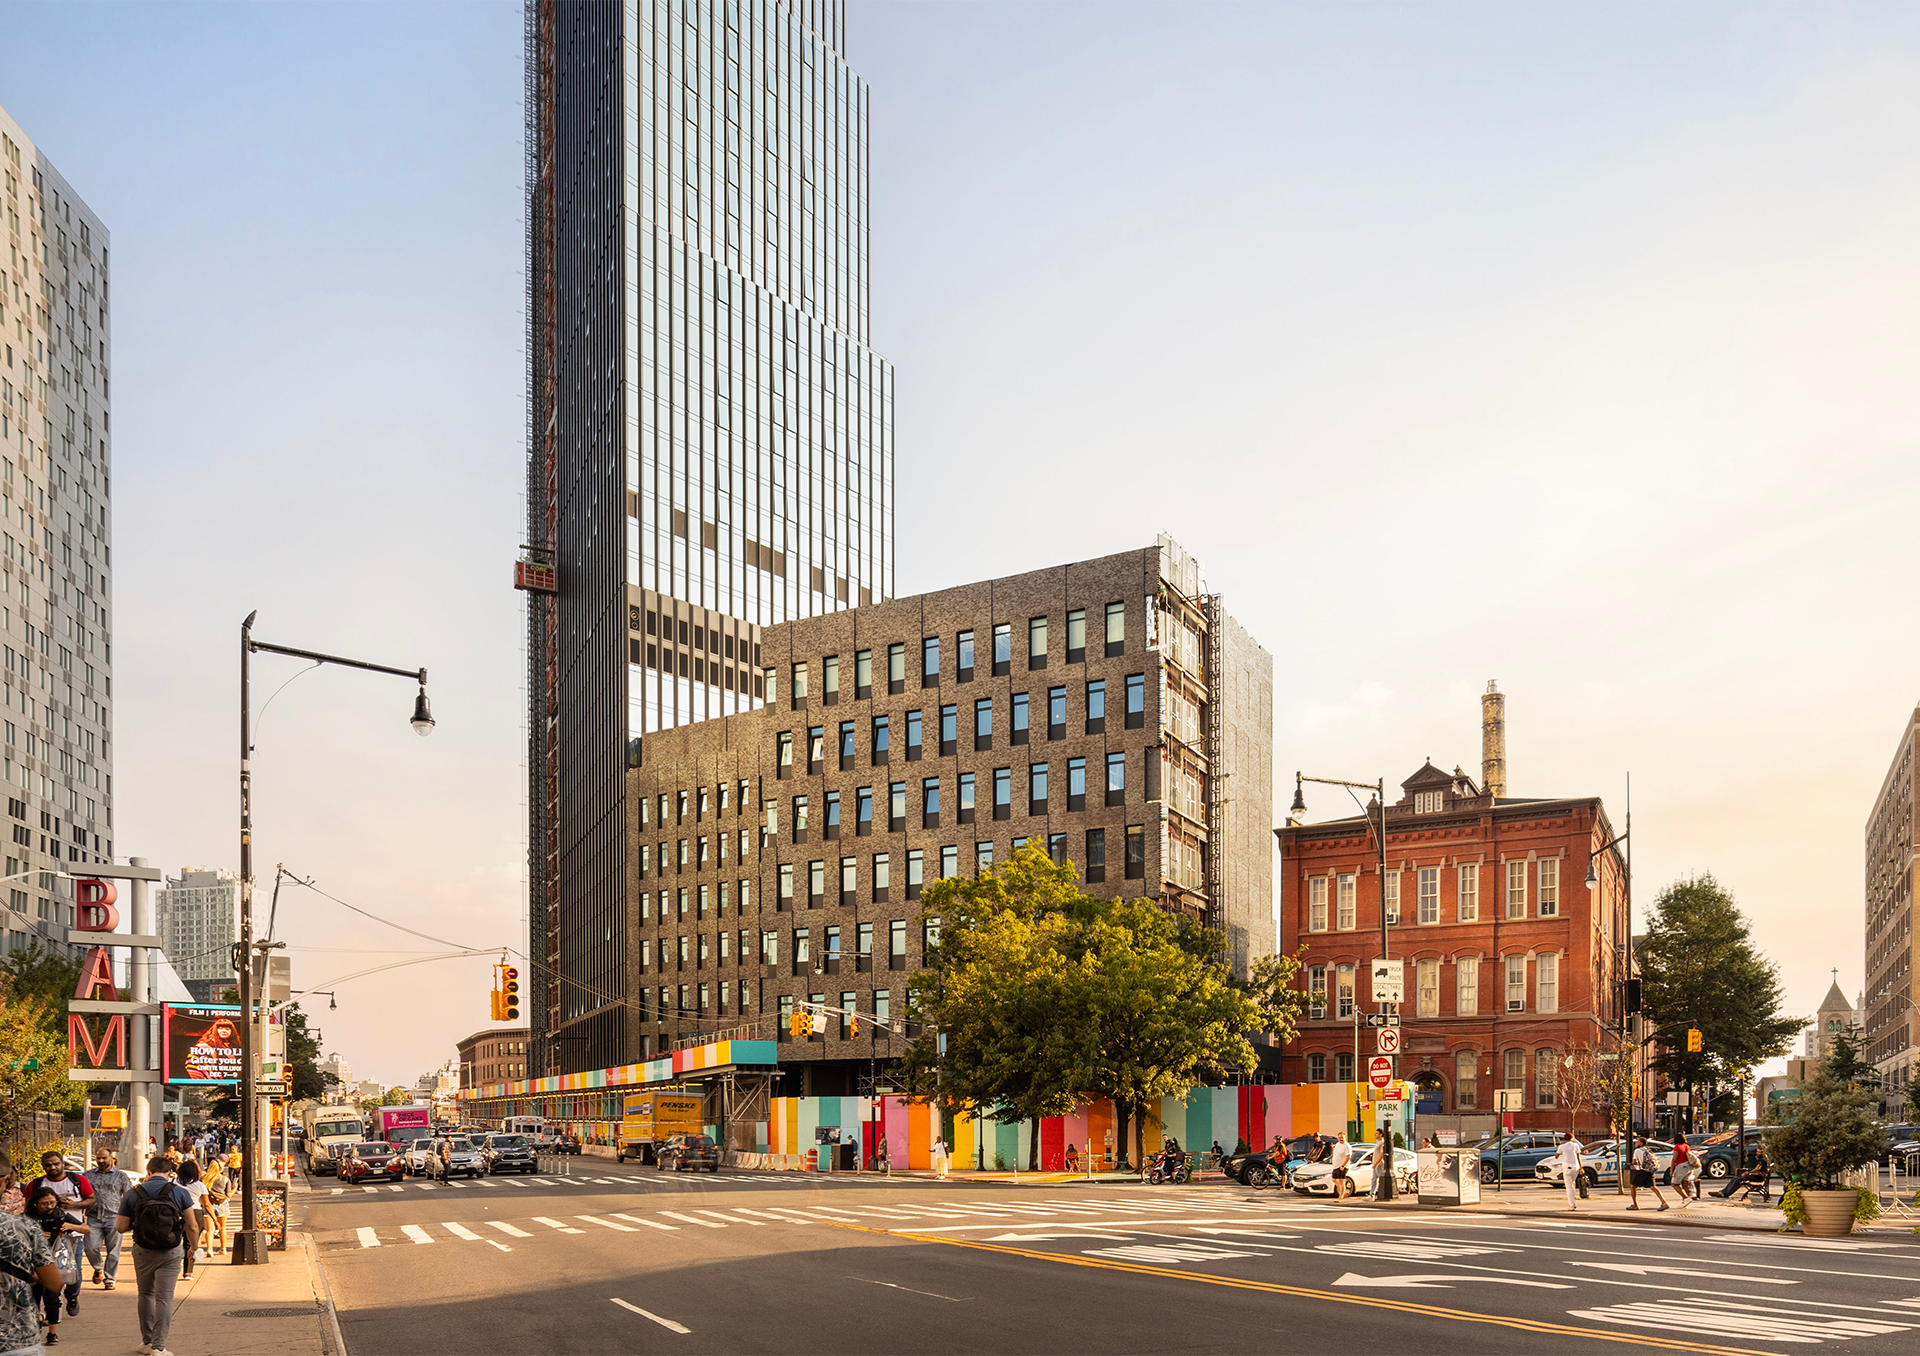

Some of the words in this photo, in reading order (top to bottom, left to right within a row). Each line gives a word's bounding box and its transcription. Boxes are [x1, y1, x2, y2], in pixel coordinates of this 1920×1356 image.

[68, 879, 125, 1067] BAM
[190, 1047, 216, 1056] HOW
[217, 1047, 232, 1056] TO
[190, 1056, 218, 1065] (after
[1378, 1103, 1398, 1111] PARK
